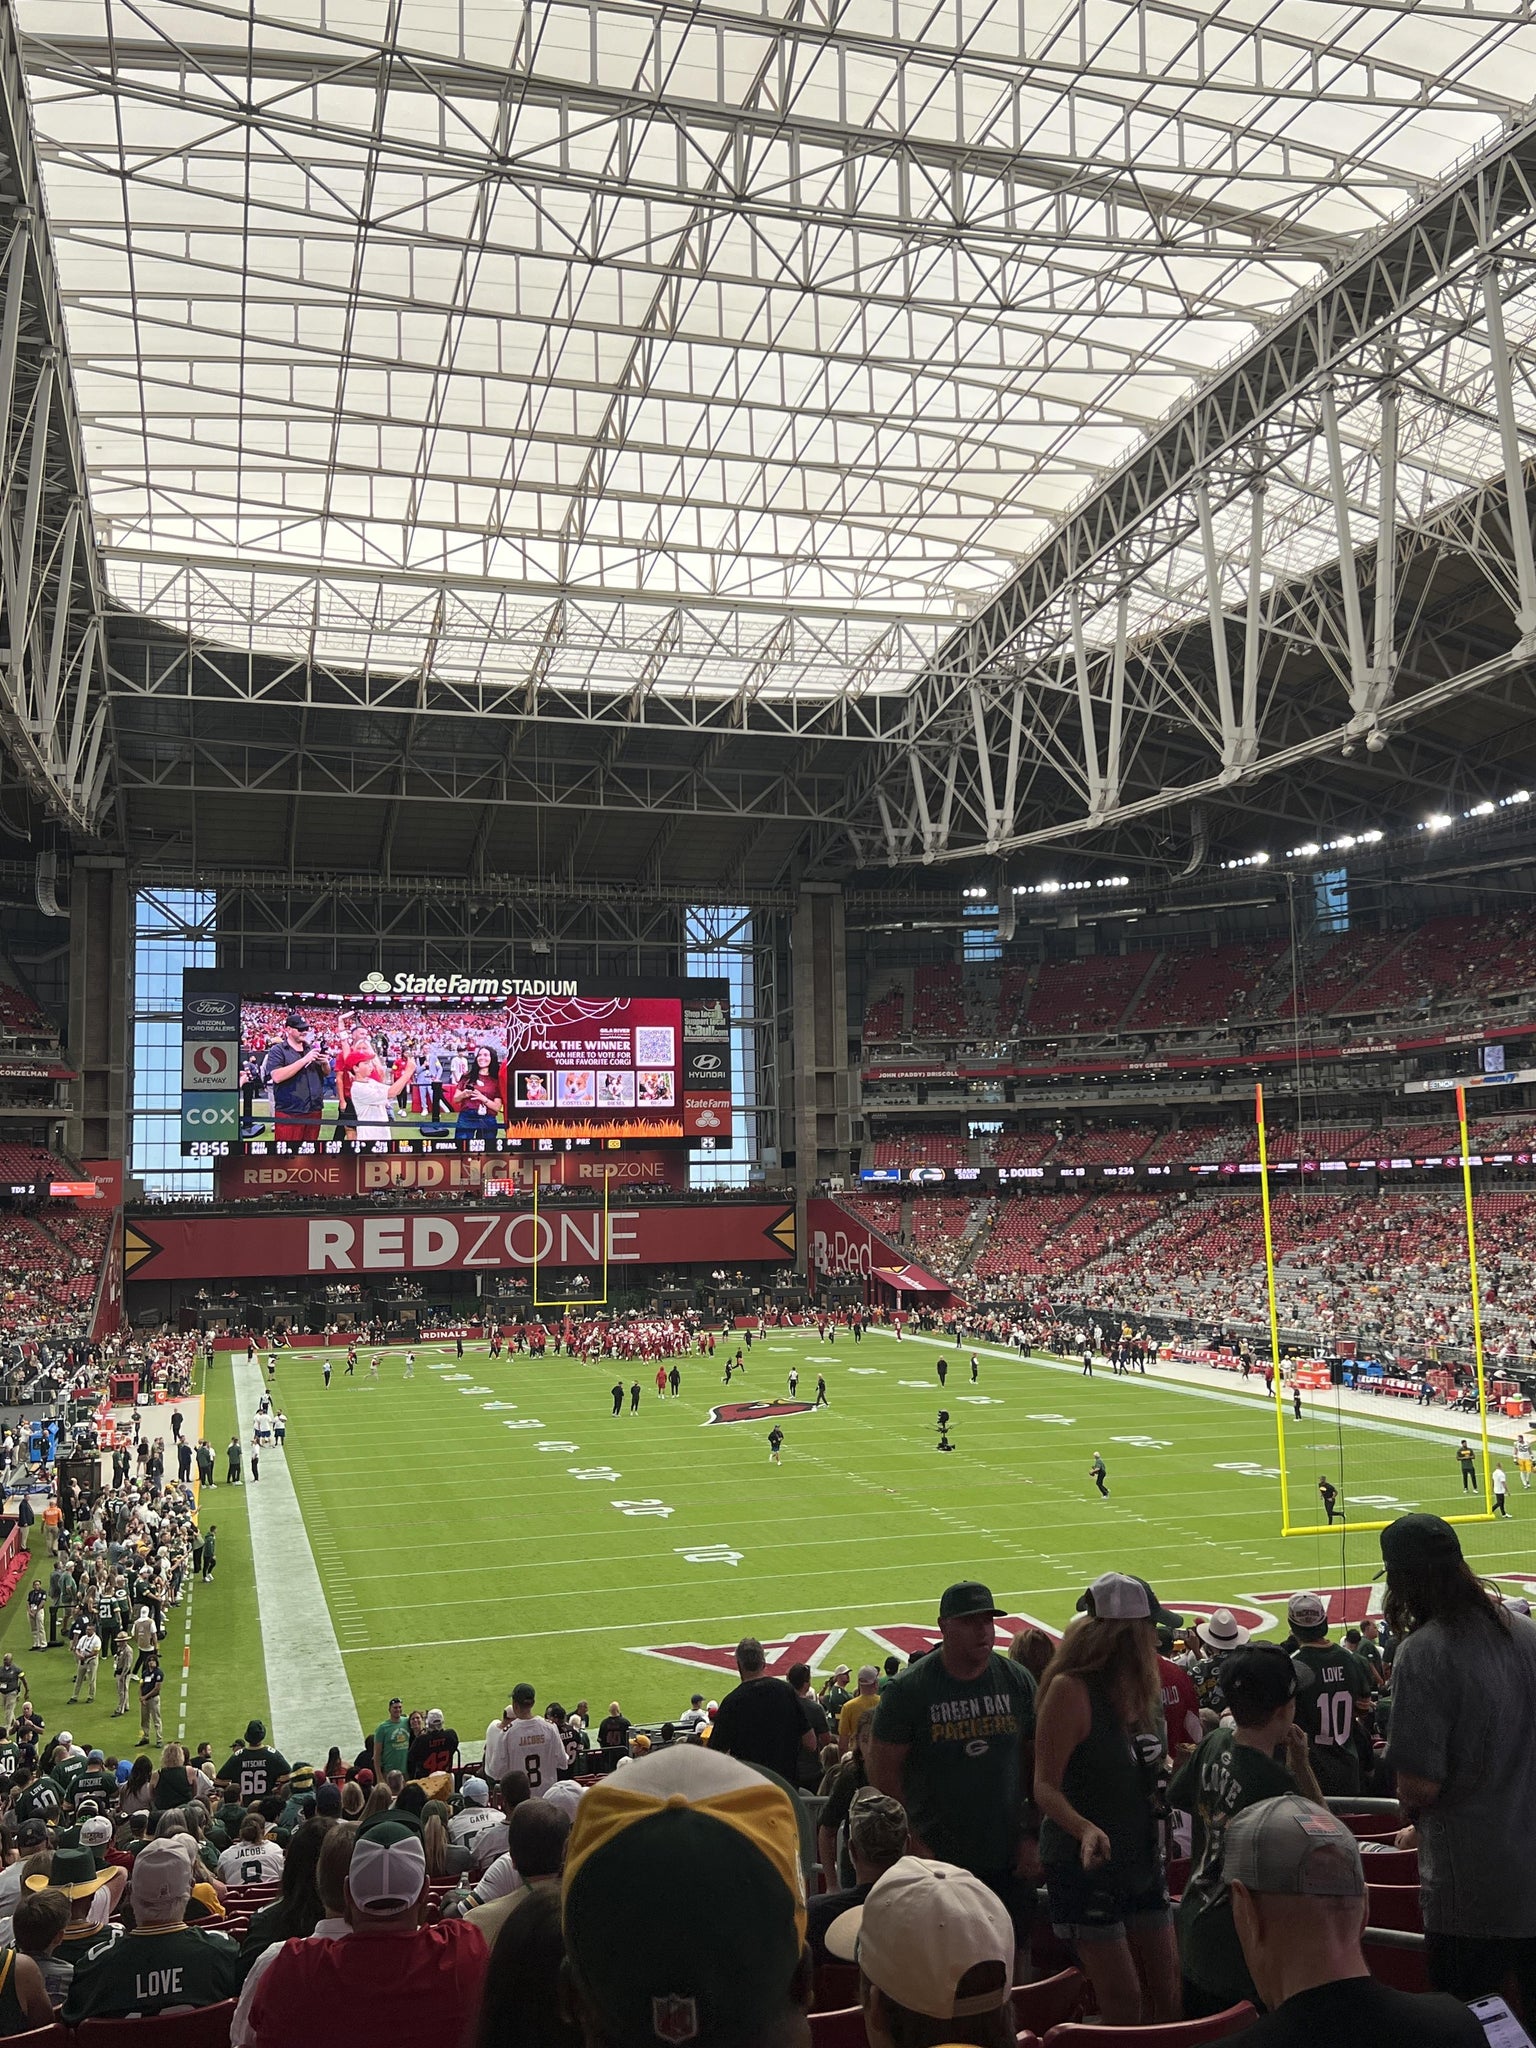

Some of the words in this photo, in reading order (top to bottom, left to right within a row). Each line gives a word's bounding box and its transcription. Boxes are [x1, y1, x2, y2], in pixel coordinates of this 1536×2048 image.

[501, 979, 578, 996] STADIUM
[197, 1001, 226, 1013] Ford
[684, 1010, 700, 1018] Shop
[684, 1018, 709, 1026] Support
[710, 1018, 726, 1026] Local
[531, 1041, 558, 1050] PICK
[561, 1041, 582, 1050] THE
[584, 1041, 631, 1051] WINNER
[1371, 1044, 1397, 1052] PALMER
[546, 1051, 566, 1059] SCAN
[567, 1051, 585, 1059] HERE
[587, 1051, 596, 1059] TO
[598, 1051, 615, 1059] VOTE
[617, 1051, 631, 1059] FOR
[688, 1071, 726, 1079] HYUNDAI
[186, 1108, 235, 1125] COX
[190, 1141, 229, 1156] 28:56
[702, 1138, 714, 1147] 25
[244, 1168, 341, 1184] REDZONE
[365, 1159, 445, 1187] BUD
[450, 1159, 557, 1186] LIGHT
[579, 1162, 665, 1178] REDZONE
[999, 1169, 1009, 1178] R.
[1012, 1168, 1044, 1177] DOUBS
[1118, 1167, 1134, 1175] 234
[1163, 1166, 1171, 1174] 4
[28, 1185, 35, 1194] 2
[308, 1211, 641, 1270] REDZONE
[419, 1330, 468, 1339] ARDINALS
[566, 1466, 622, 1480] 30
[610, 1499, 676, 1516] 20
[673, 1544, 745, 1563] 10
[100, 1605, 112, 1618] 21
[1322, 1666, 1345, 1683] LOVE
[930, 1698, 980, 1723] GREEN
[983, 1694, 1012, 1715] BAY
[1314, 1690, 1353, 1746] 10
[931, 1715, 1018, 1742] PACKERS
[519, 1734, 545, 1746] JACOBS
[241, 1760, 267, 1768] NITSCHKE
[525, 1754, 542, 1788] 8
[241, 1770, 267, 1795] 66
[30, 1783, 45, 1796] LOVE
[469, 1814, 490, 1824] GARY
[235, 1846, 267, 1860] JACOBS
[136, 1967, 183, 1999] LOVE
